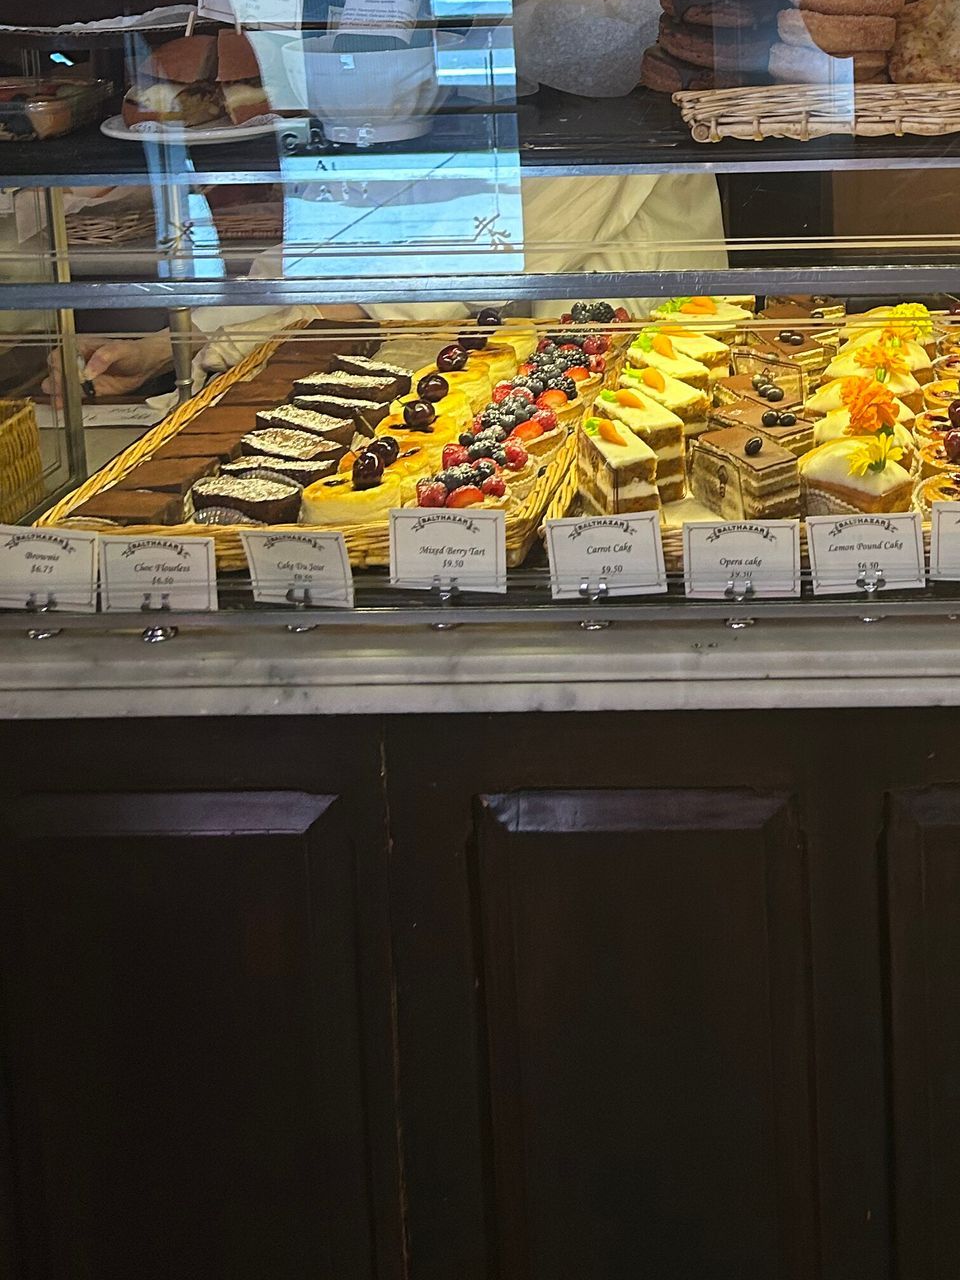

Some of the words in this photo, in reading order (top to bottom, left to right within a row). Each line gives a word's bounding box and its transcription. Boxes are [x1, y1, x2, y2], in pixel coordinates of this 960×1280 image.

[422, 515, 469, 526] BALTHAZAR
[577, 520, 626, 531] BALTHAZAR
[838, 518, 886, 529] BALTHAZAR
[717, 525, 765, 535] BALTHAZAR
[16, 533, 65, 545] BALTHAZAR
[271, 536, 312, 546] BALTHAZAR
[132, 540, 180, 551] BALTHAZAR
[586, 543, 611, 554] Carrot
[613, 542, 633, 553] Cake
[828, 543, 855, 553] Lemon
[856, 541, 882, 551] Pound
[884, 540, 903, 551] Cake
[419, 545, 444, 555] Mixed
[446, 545, 467, 558] Berry
[469, 547, 486, 556] Tart
[134, 562, 153, 572] Choc
[277, 561, 294, 570] Cake
[442, 559, 464, 569] $9.50
[720, 557, 743, 568] Opera
[744, 556, 762, 567] cake
[601, 565, 623, 574] $9.50
